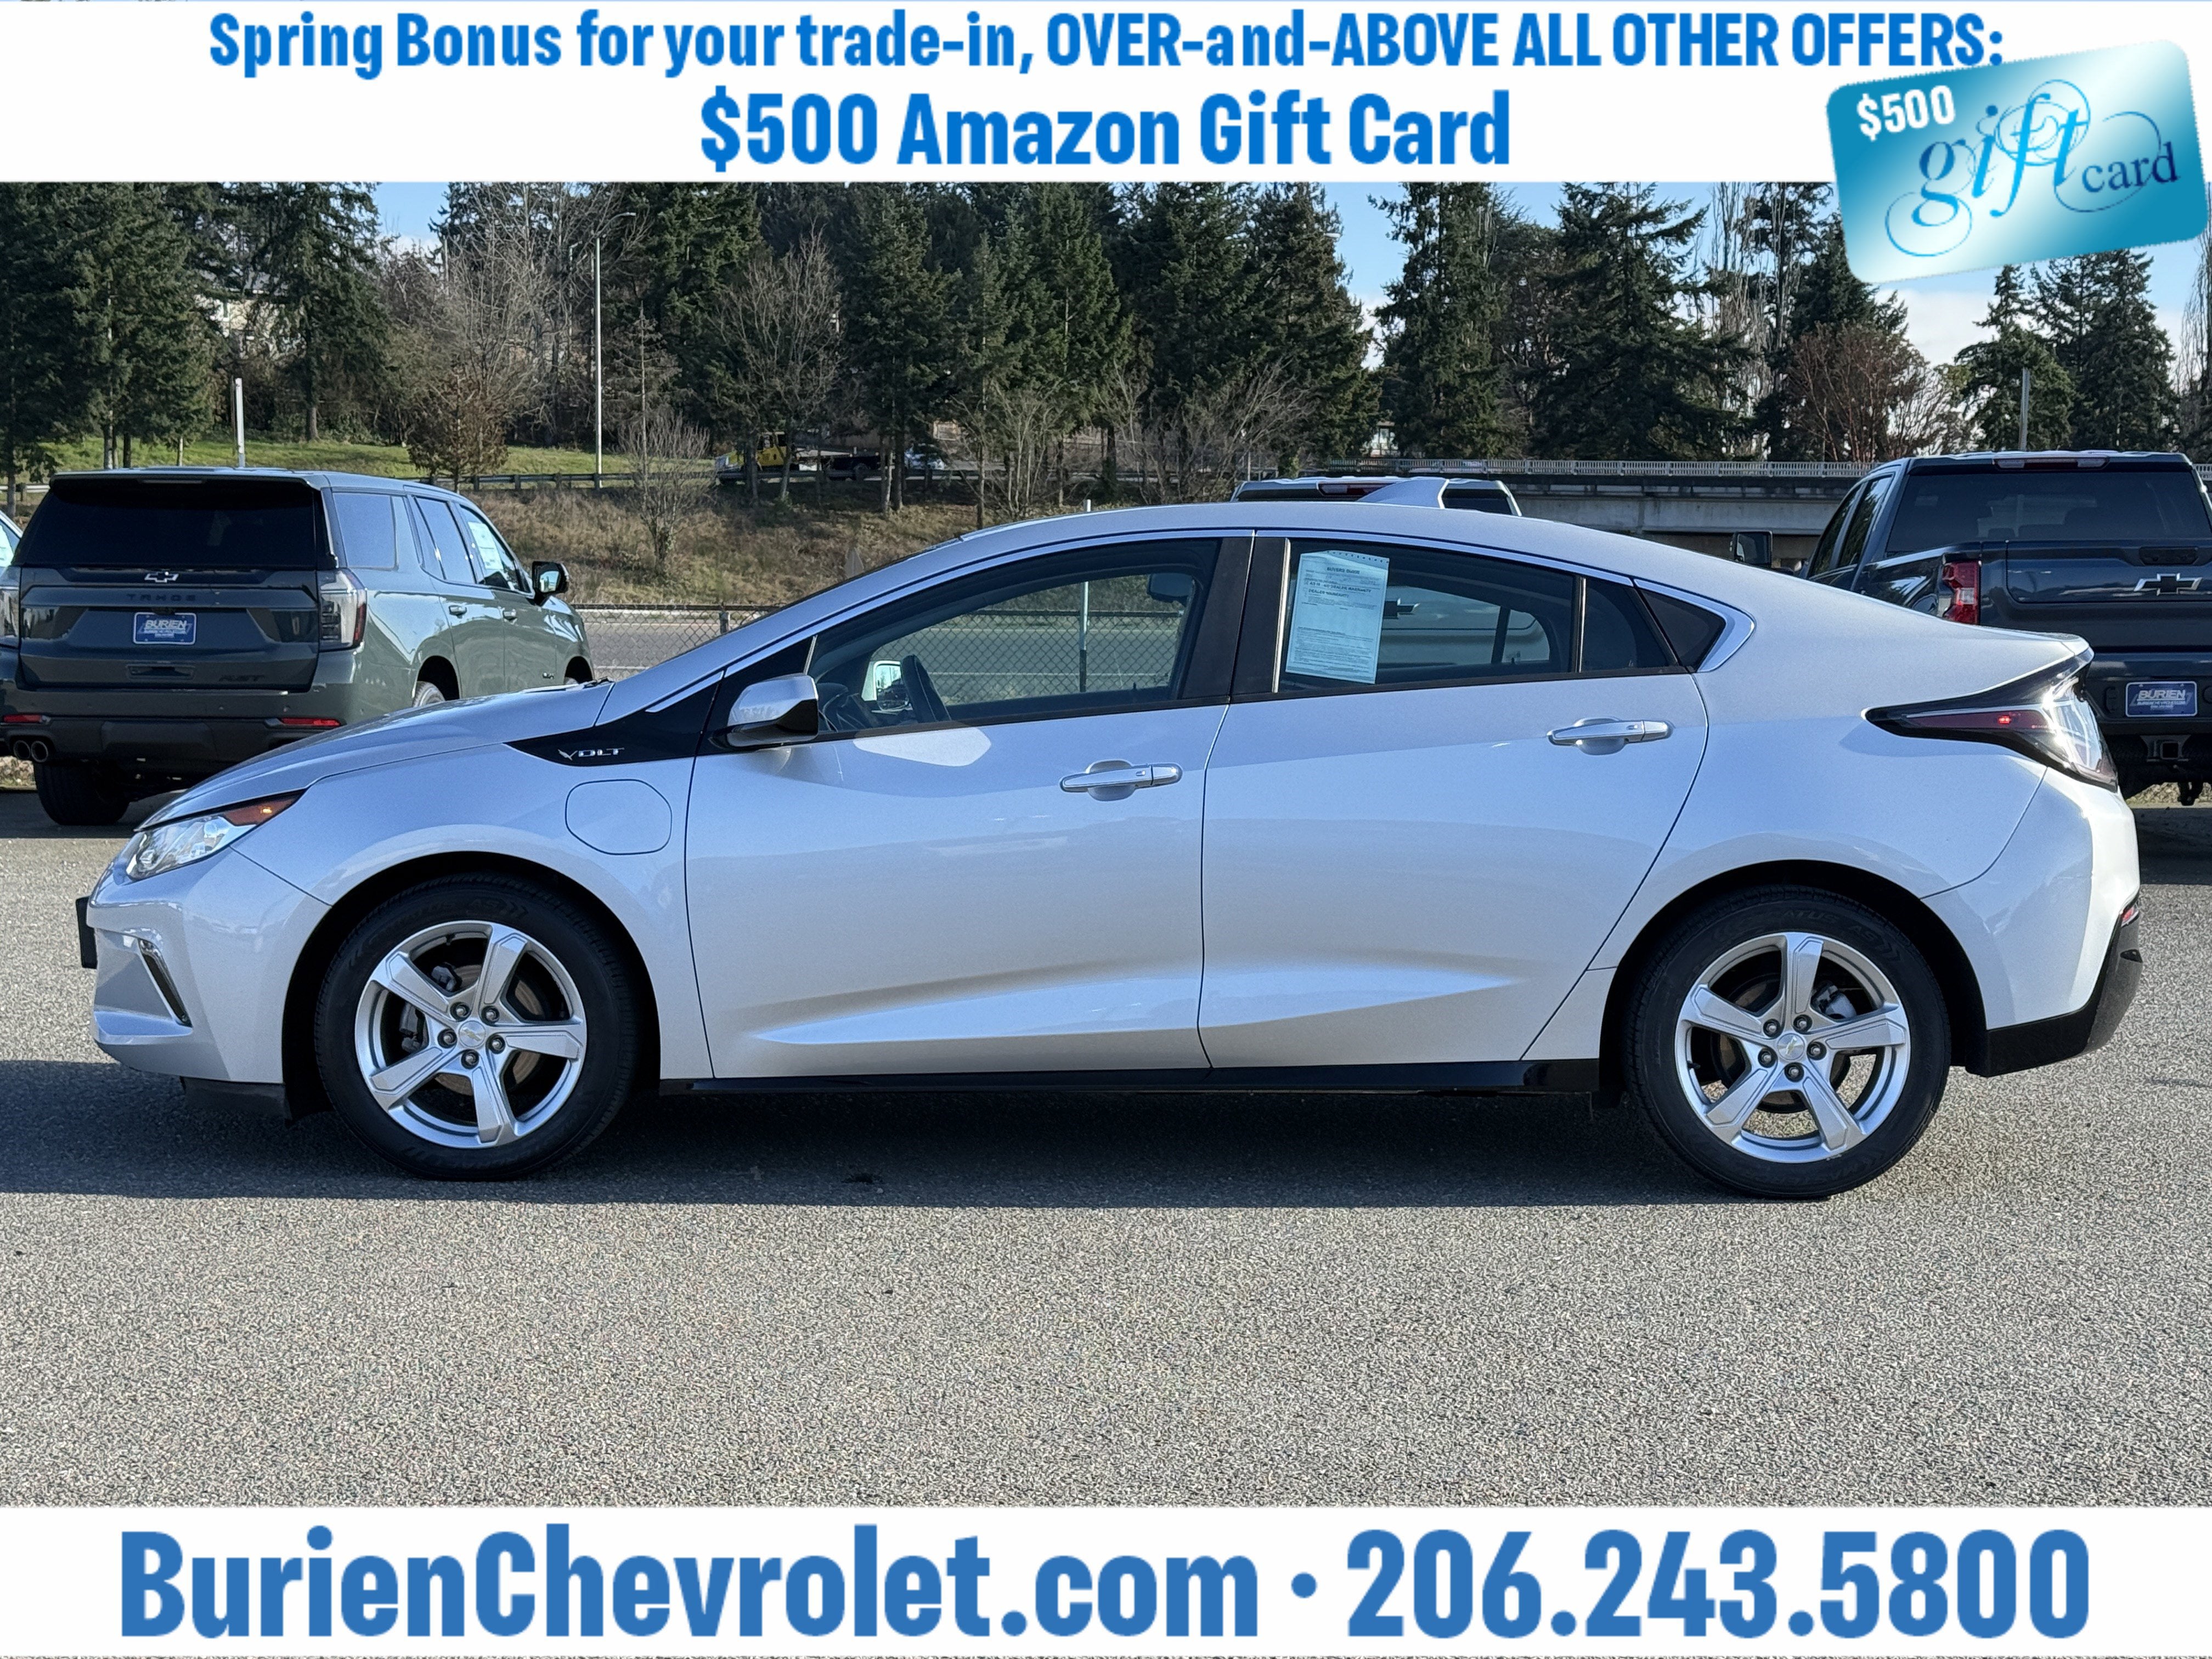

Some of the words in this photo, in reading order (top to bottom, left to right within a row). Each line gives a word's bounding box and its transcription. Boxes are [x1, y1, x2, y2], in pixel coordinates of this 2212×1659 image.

[126, 593, 196, 601] TAHOE
[144, 619, 188, 629] BURIEN
[2138, 690, 2186, 699] BURIEN
[557, 747, 625, 761] VOLT
